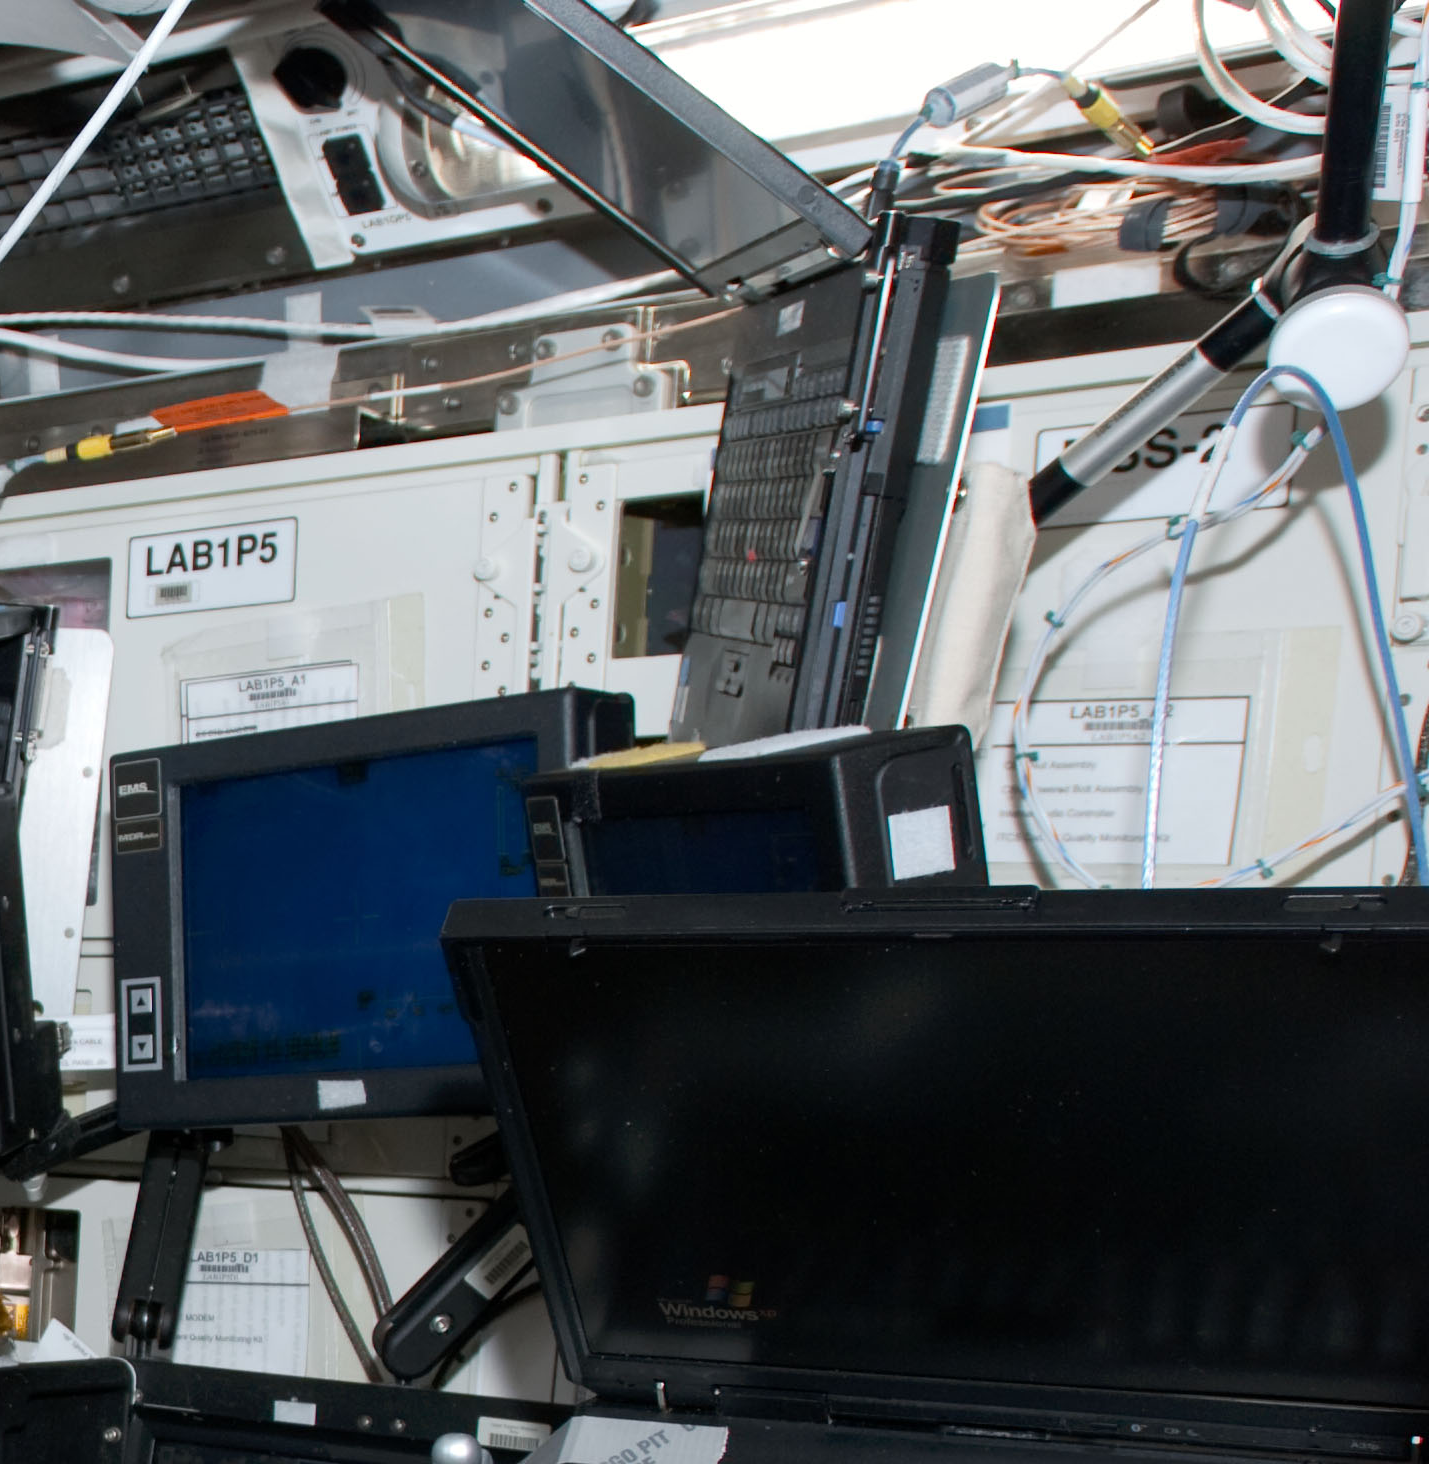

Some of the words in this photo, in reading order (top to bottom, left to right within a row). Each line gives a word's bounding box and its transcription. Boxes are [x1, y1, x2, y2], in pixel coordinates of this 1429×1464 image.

[145, 532, 278, 577] LAB1P5
[117, 782, 149, 798] EMS
[658, 1301, 759, 1321] Windows
[666, 1316, 742, 1329] Professional
[636, 1429, 670, 1455] PIT
